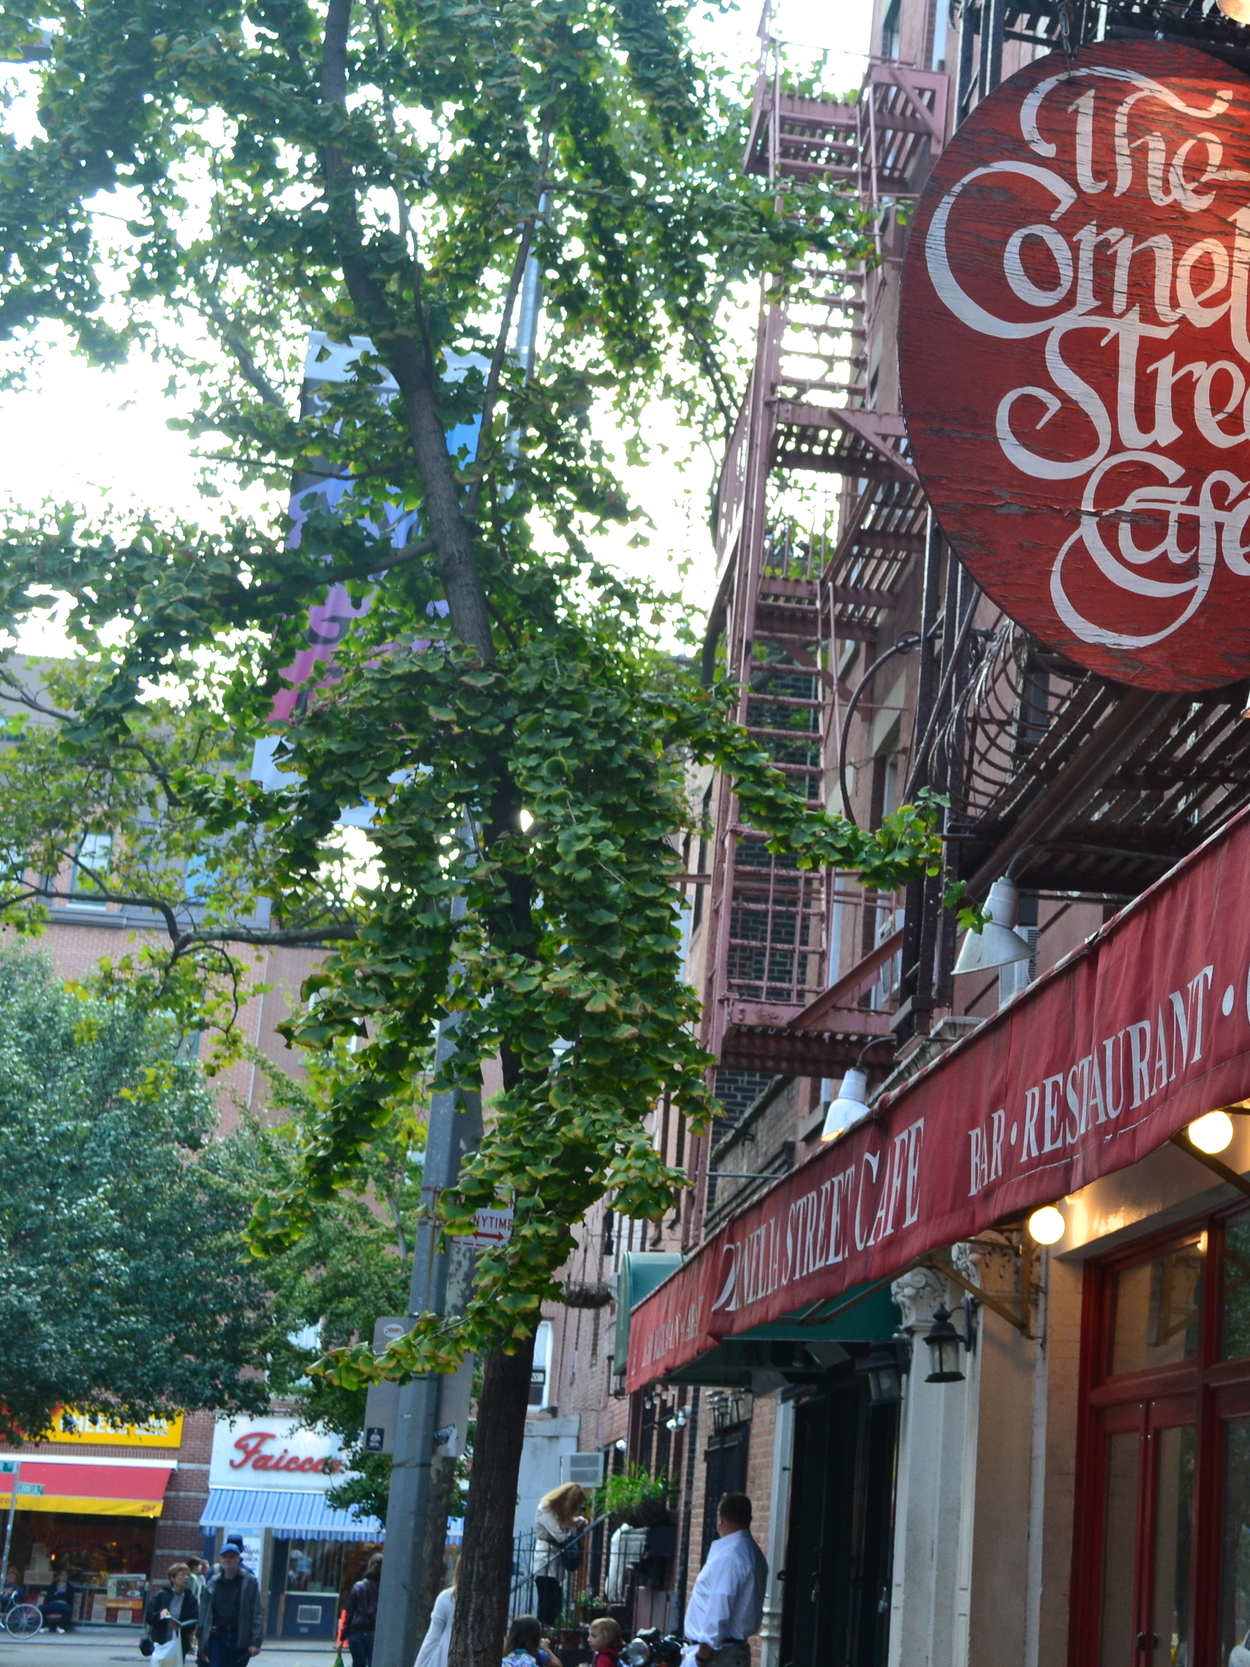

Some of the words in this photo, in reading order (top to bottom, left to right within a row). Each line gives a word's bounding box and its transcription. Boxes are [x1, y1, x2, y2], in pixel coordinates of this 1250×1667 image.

[781, 1164, 856, 1286] STREET
[855, 1116, 925, 1251] CAFE
[1020, 964, 1214, 1164] RESTAURANT
[472, 1214, 514, 1231] NYTIME
